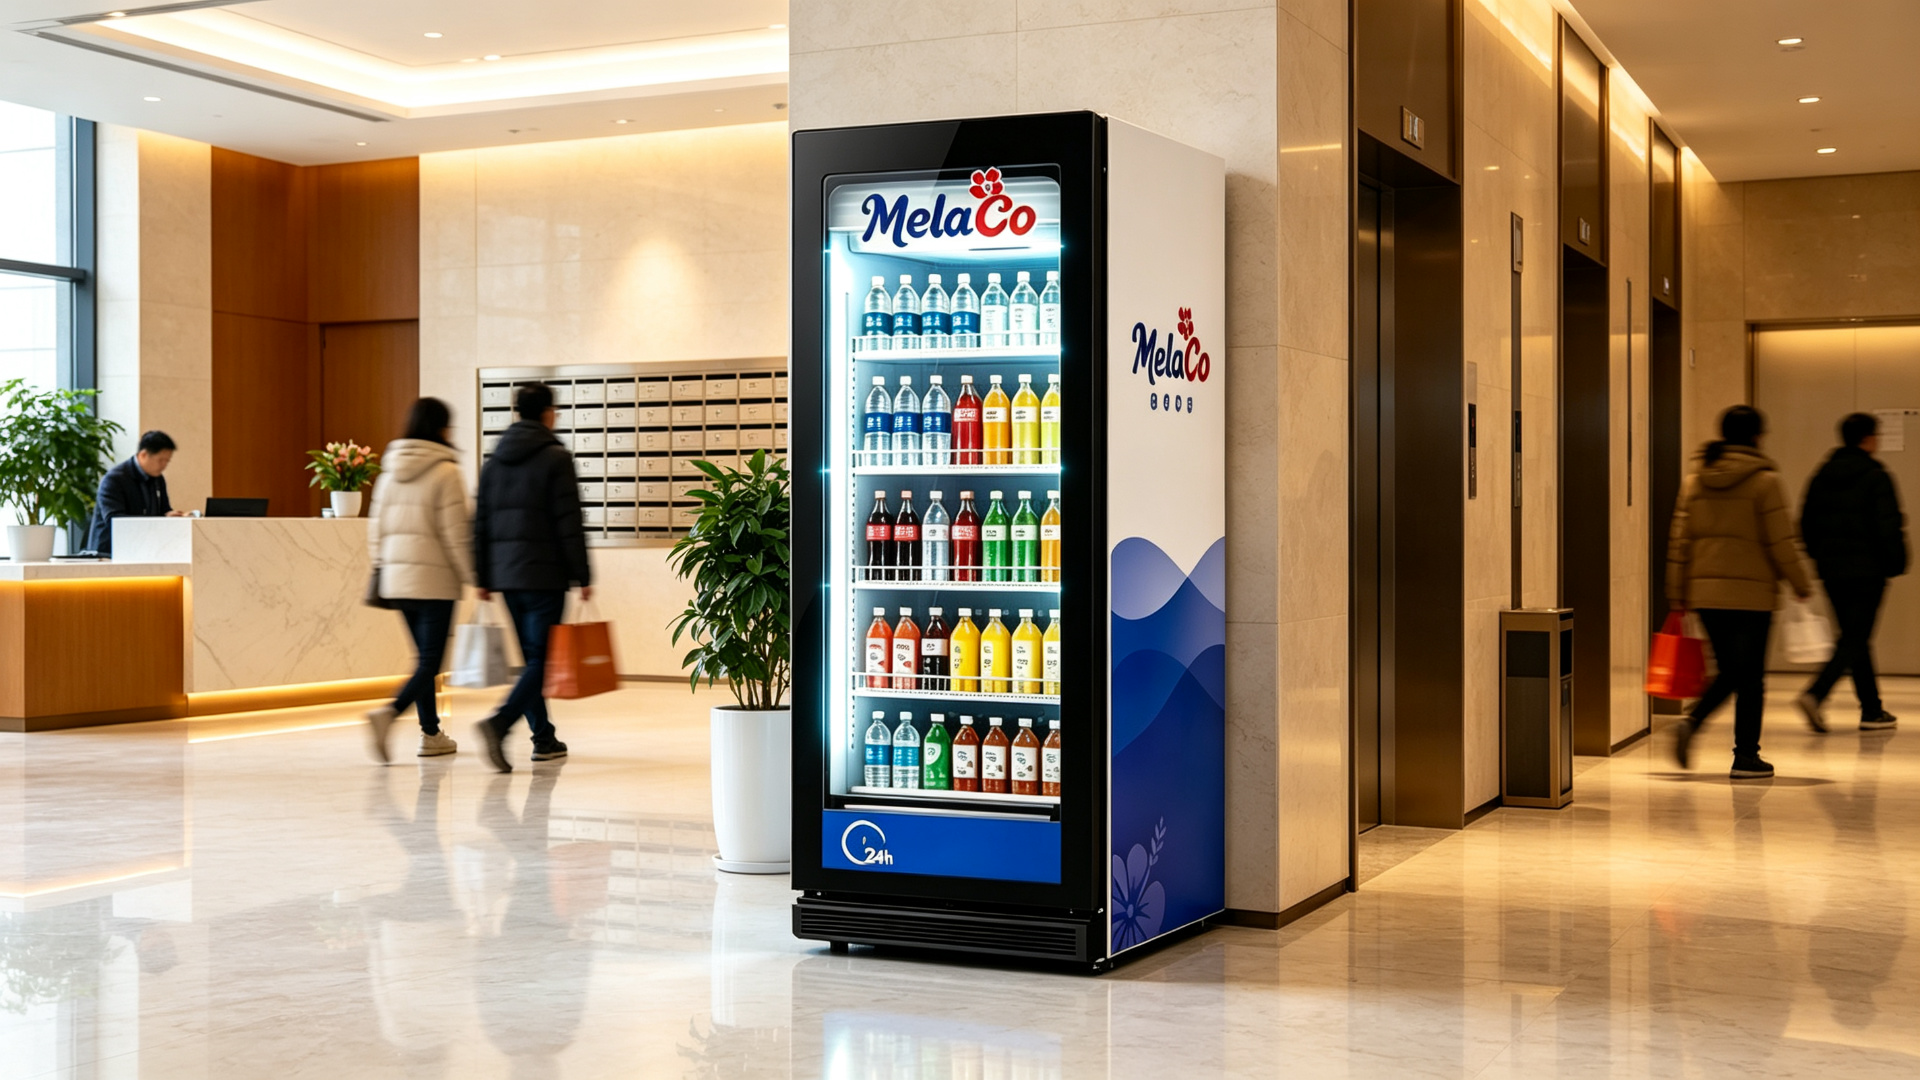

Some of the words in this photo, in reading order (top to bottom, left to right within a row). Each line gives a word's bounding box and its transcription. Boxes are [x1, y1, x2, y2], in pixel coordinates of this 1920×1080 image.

[861, 193, 1037, 247] MelaCo
[1132, 321, 1211, 386] MelaCo
[864, 847, 894, 865] 24h
